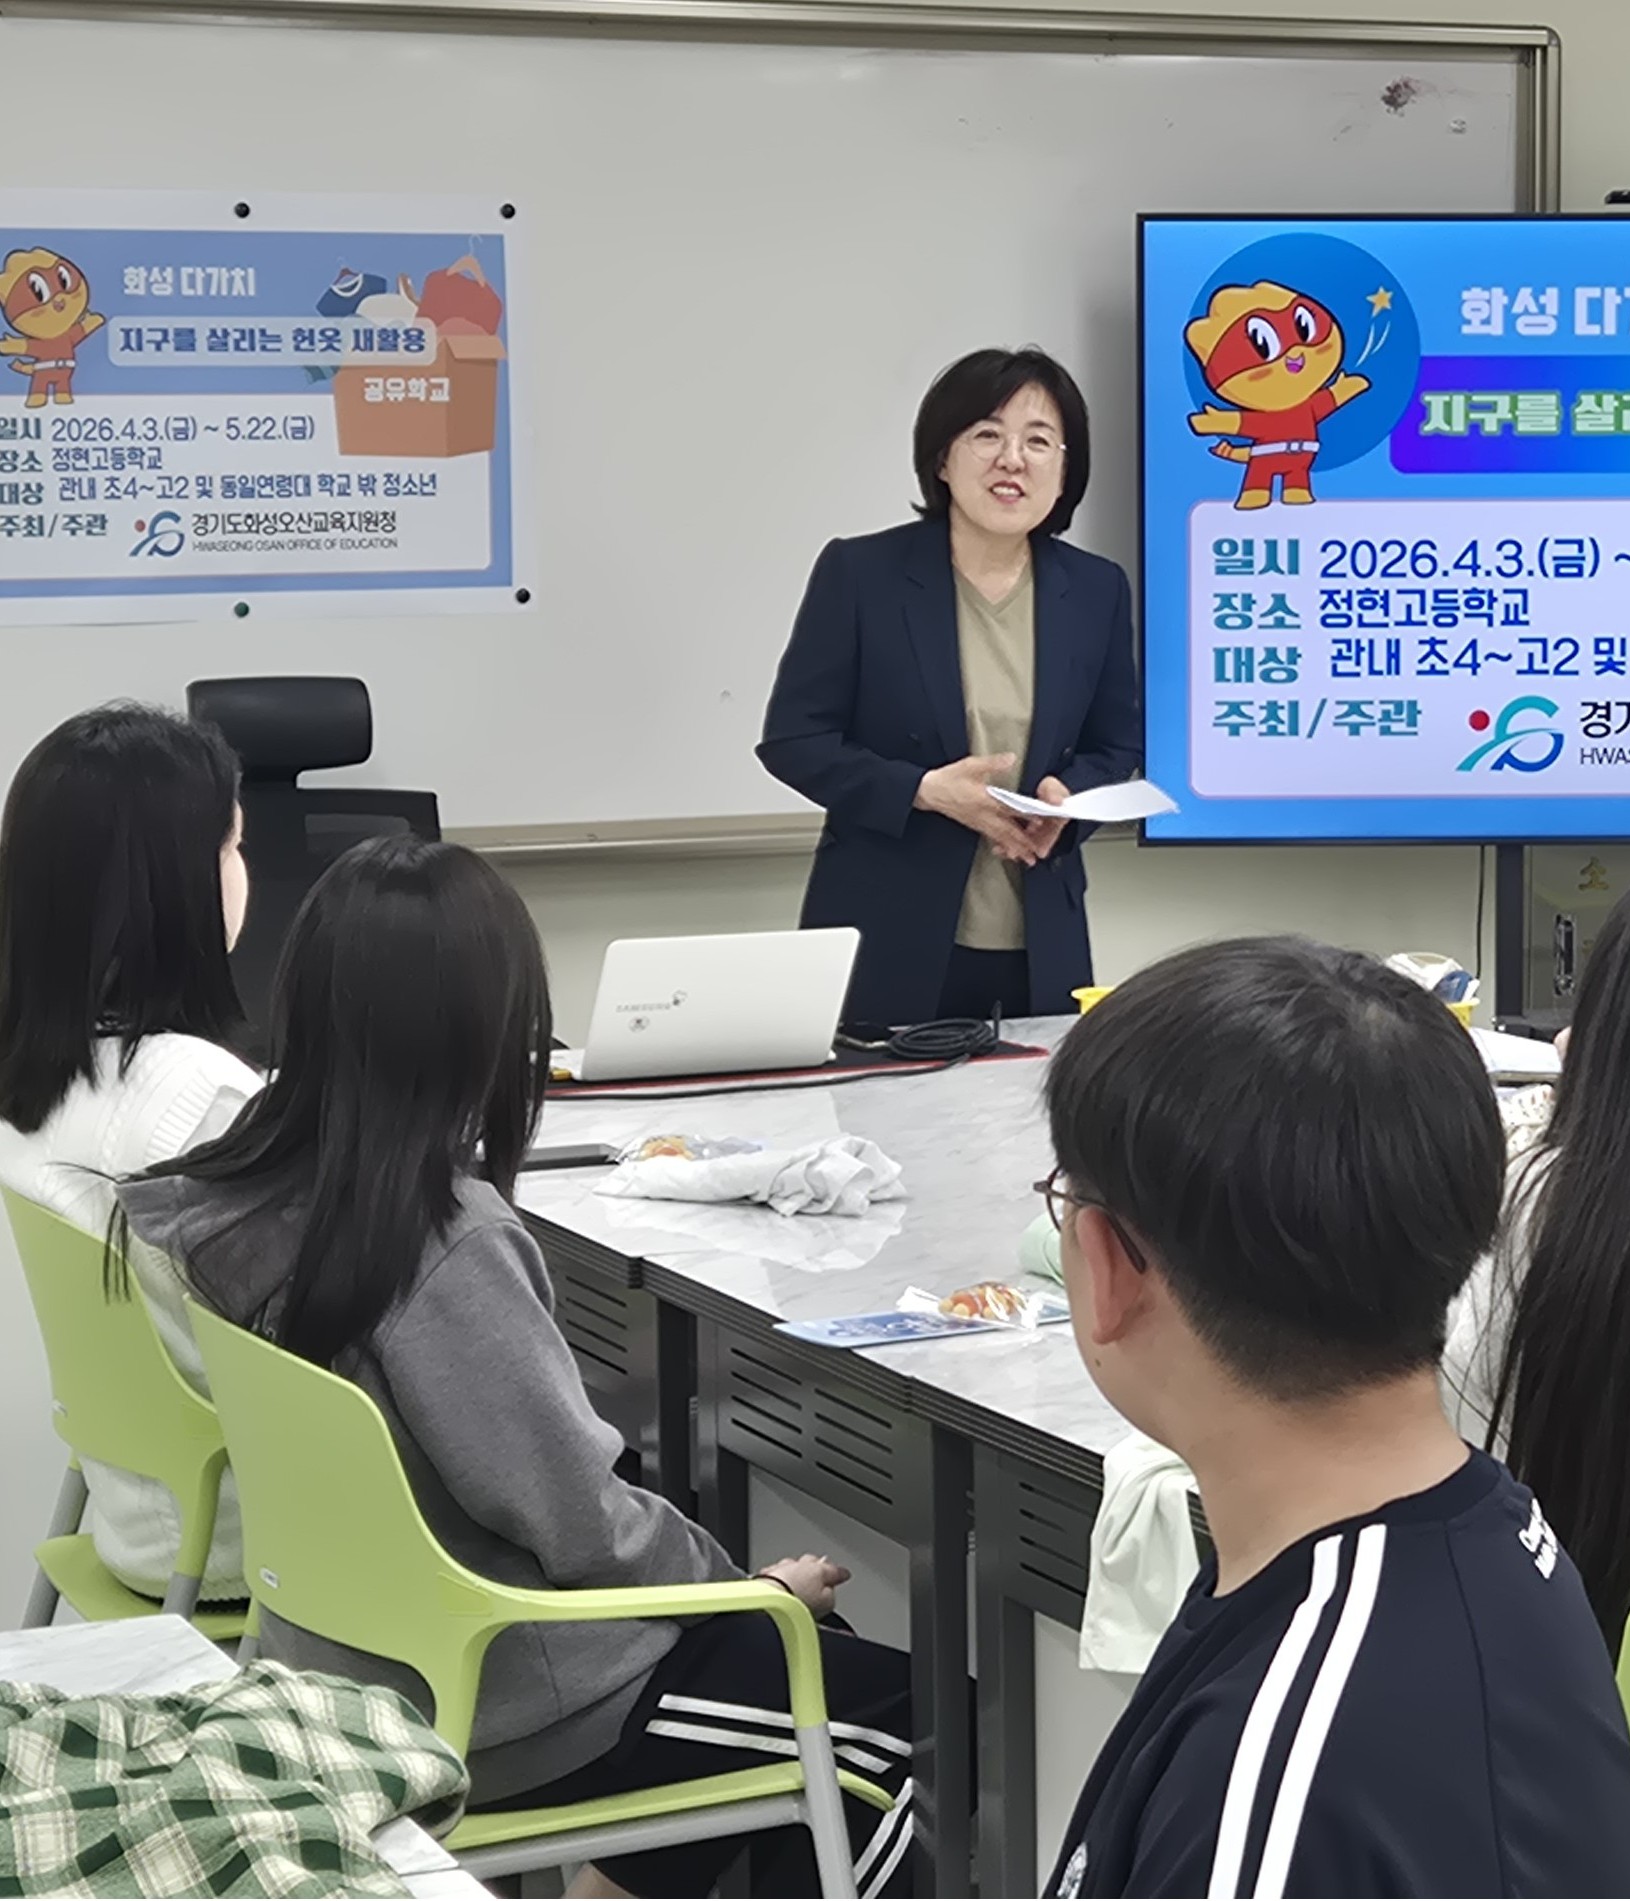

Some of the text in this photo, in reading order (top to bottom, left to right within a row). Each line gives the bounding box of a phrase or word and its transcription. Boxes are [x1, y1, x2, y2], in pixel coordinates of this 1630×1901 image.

[123, 266, 255, 297] 화성 다가치
[1460, 286, 1560, 336] 화성
[119, 327, 426, 352] 지구를 살리는 헌옷 새활용
[364, 377, 450, 402] 공유학교
[0, 417, 42, 440] 일시
[51, 417, 197, 441] 2026.4.3.(금)
[225, 416, 315, 440] 5.22.(금)
[1421, 392, 1560, 434] 지구를
[0, 446, 162, 473] 장소 정현고등학교
[0, 472, 437, 505] 대상 관내 초4~고2 및 동일연령대 학교 밖 청소년
[192, 510, 396, 536] 경기도화성오산교육지원청
[192, 537, 398, 551] HWASEONG OSAN OFFICE OF EDUCATION
[1212, 538, 1300, 576] 일시
[1320, 537, 1600, 578] 2026.4.3.(금)
[1212, 588, 1530, 630] 장소 정현고등학교
[1212, 646, 1302, 684] 대상
[1331, 638, 1400, 678] 관내
[1416, 637, 1579, 677] 초4~고2
[1594, 637, 1626, 676] 및
